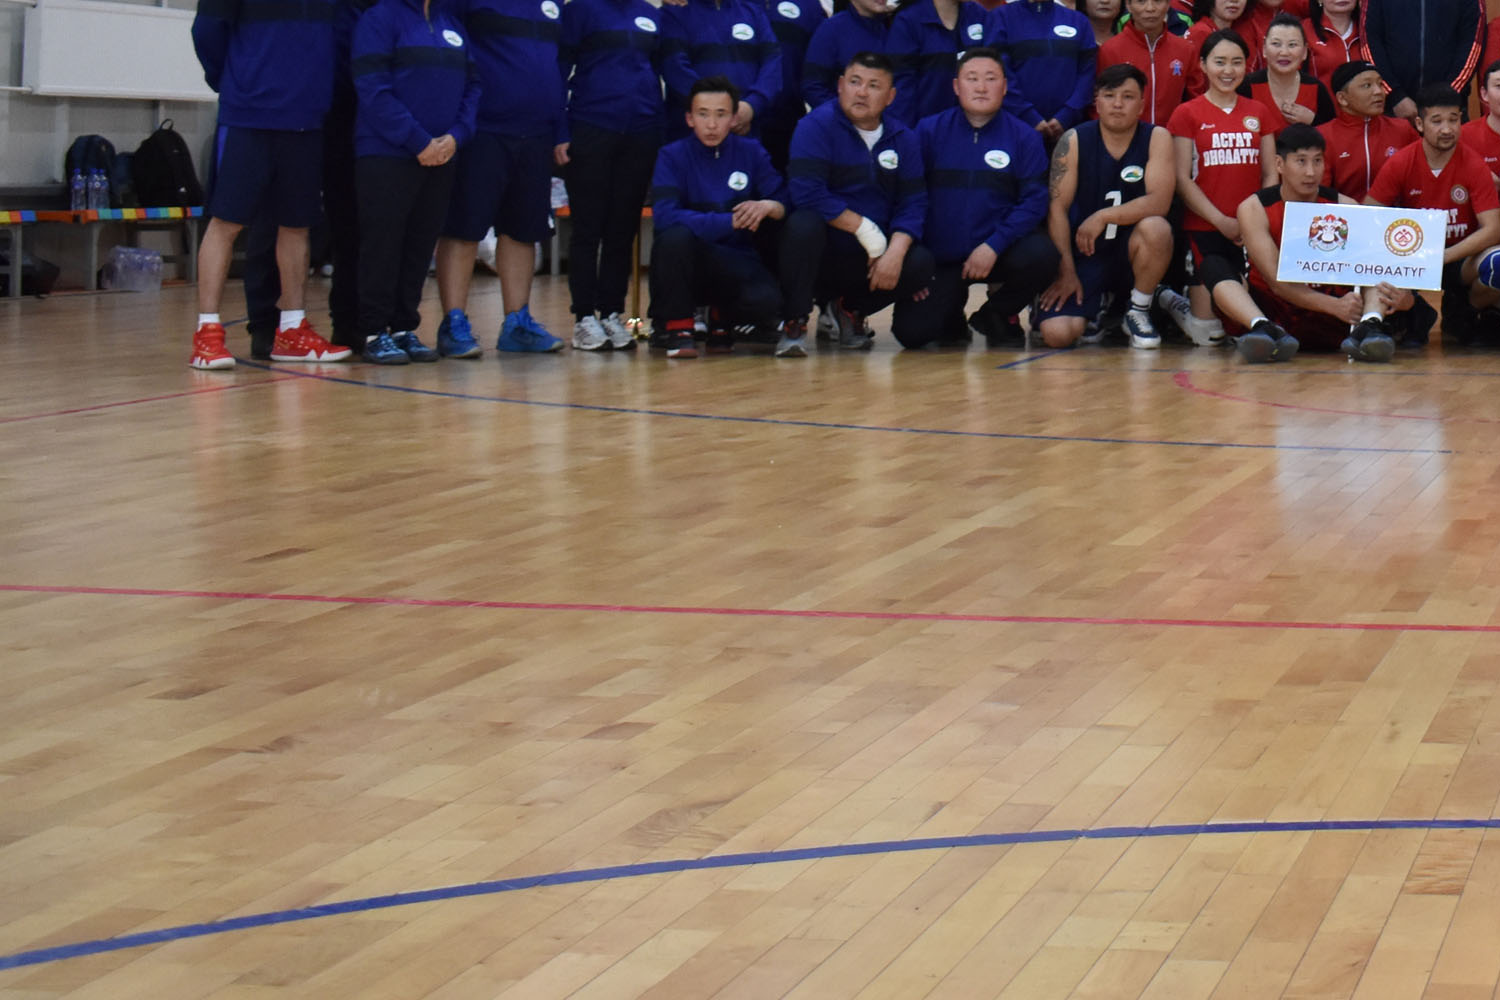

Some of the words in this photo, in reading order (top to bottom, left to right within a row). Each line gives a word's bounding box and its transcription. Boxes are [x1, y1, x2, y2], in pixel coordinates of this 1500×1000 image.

[1212, 132, 1253, 148] АСГАТ
[1296, 260, 1350, 273] "АСГАТ"
[1354, 263, 1426, 277] ОНӨААТҮГ
